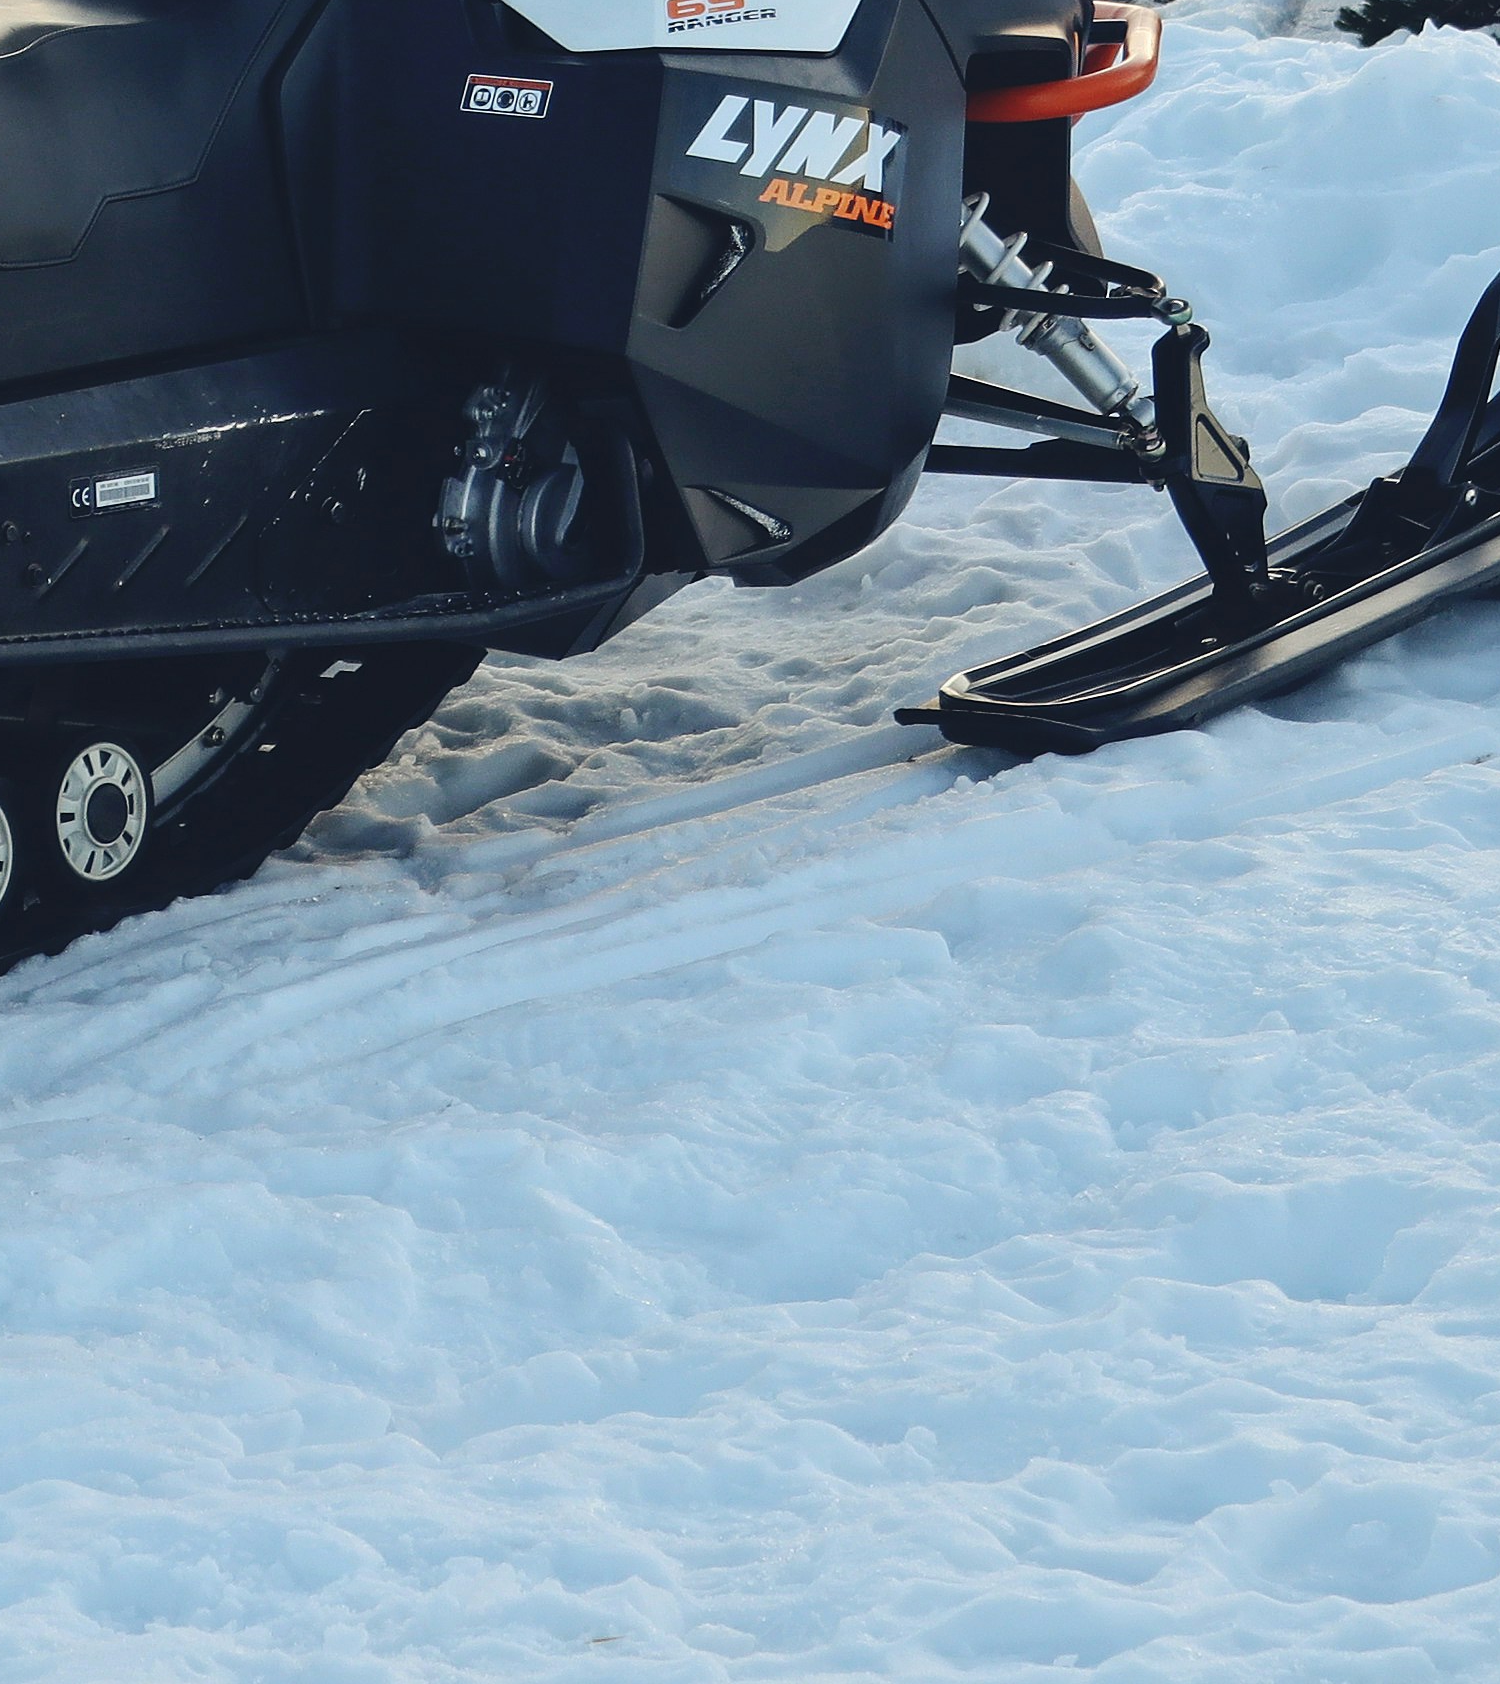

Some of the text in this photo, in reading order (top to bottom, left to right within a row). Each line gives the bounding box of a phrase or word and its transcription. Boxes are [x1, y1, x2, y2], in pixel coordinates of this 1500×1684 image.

[667, 8, 777, 34] RANGER
[685, 94, 901, 193] LYNX
[757, 177, 896, 230] ALPINE
